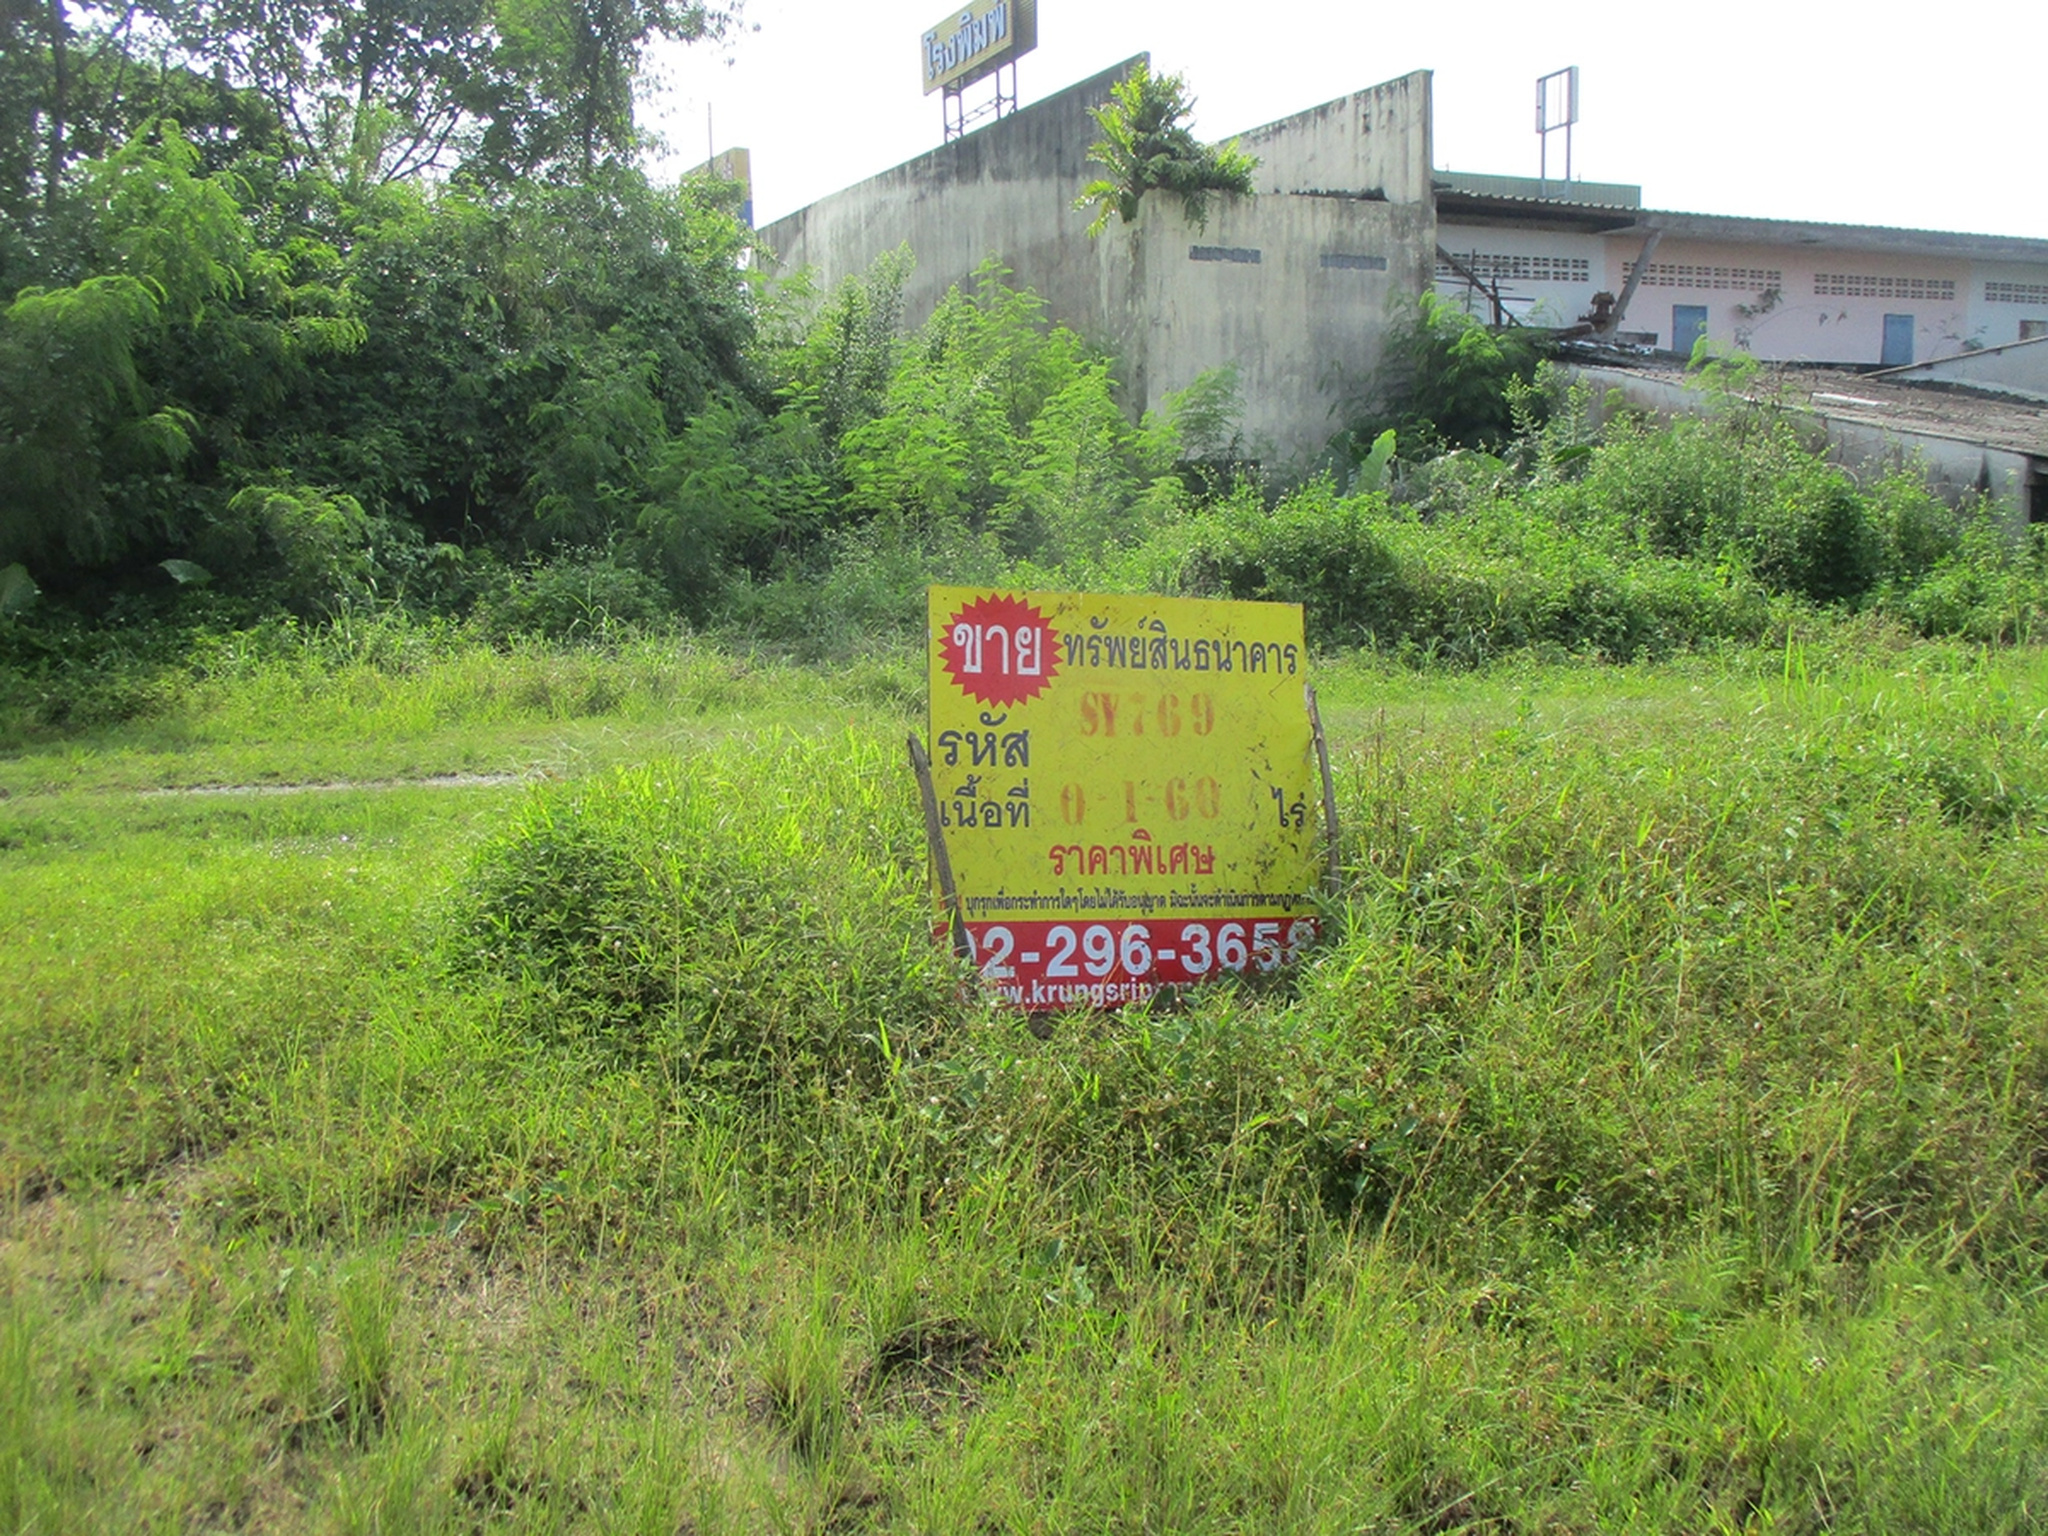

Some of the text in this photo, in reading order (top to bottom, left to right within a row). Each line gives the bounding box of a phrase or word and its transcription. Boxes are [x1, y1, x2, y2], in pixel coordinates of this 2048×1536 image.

[923, 0, 1007, 80] โรงพิมพ
[953, 621, 1042, 677] ขาย
[1063, 615, 1298, 675] ทรัพย์สินธนาคาร
[938, 711, 1030, 768] รหัส
[940, 774, 1031, 828] เนื้อที่
[1271, 784, 1306, 828] ไร่
[1048, 827, 1217, 877] ราคาพิเศษ
